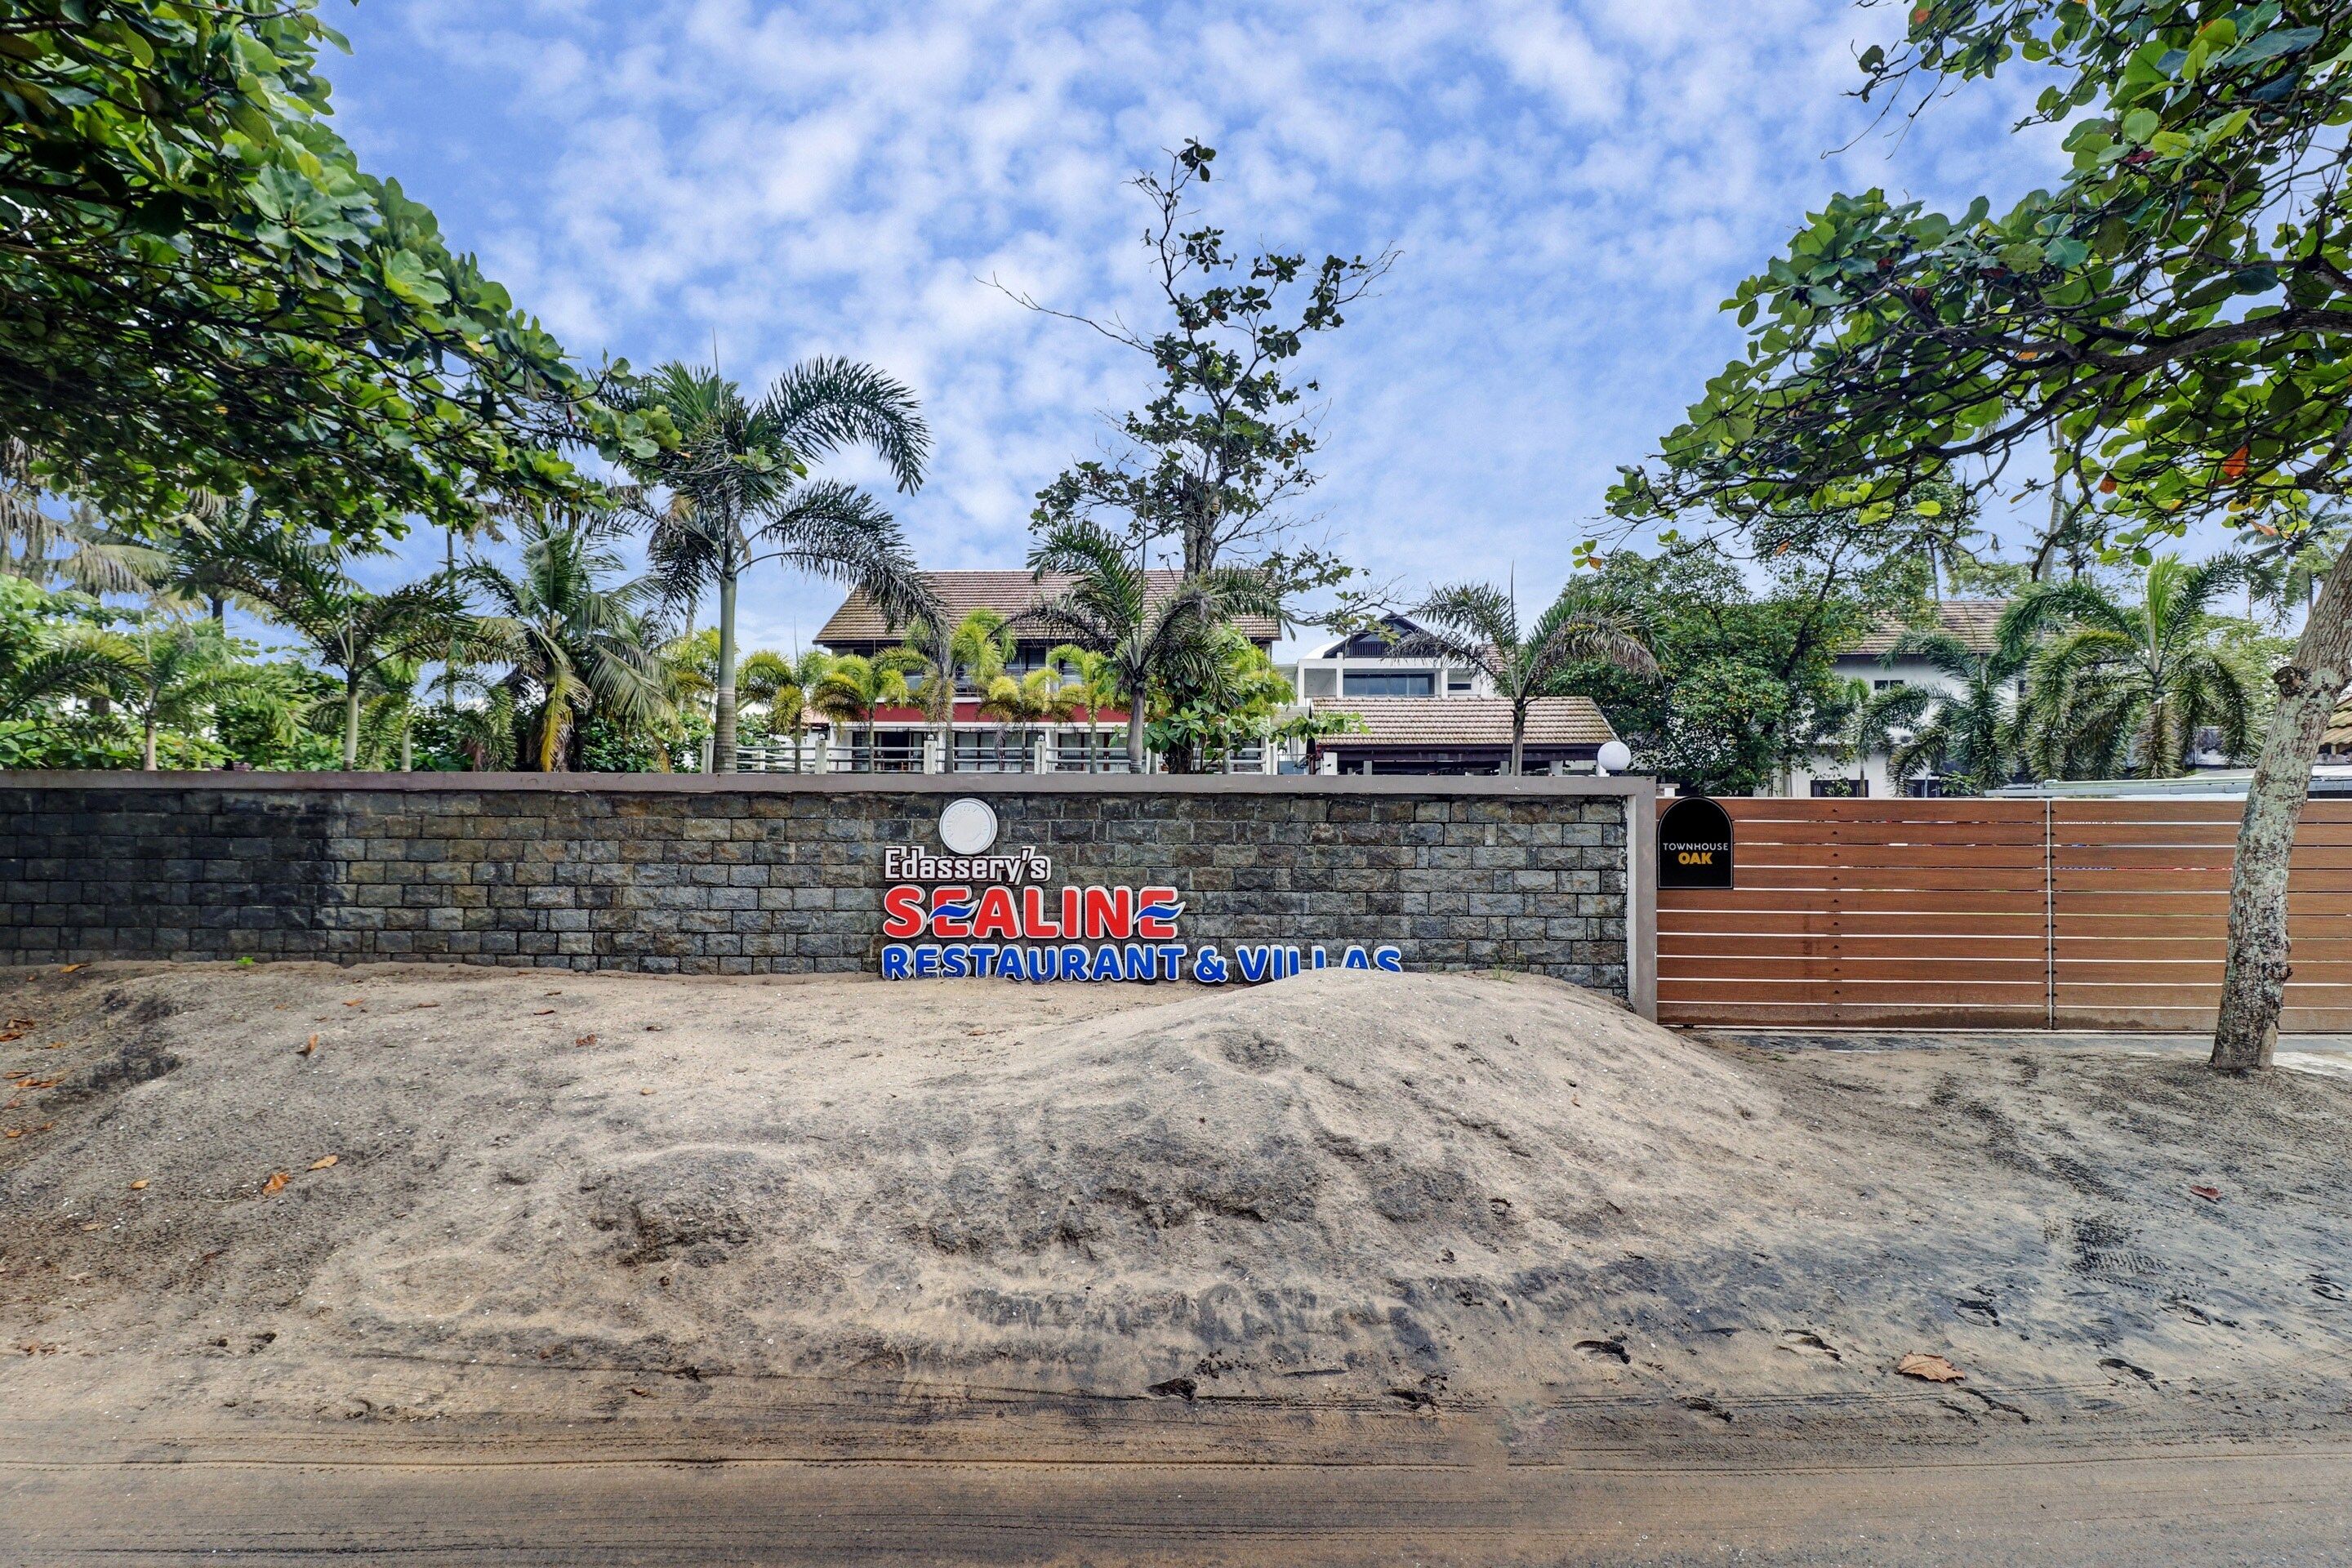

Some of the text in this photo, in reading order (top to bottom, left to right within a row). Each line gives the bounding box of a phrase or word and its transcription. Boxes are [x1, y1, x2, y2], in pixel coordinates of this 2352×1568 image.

[884, 846, 1051, 884] Edassery's
[1663, 843, 1729, 851] TOWNHOUSE
[1678, 853, 1713, 865] OAK
[883, 885, 1186, 939] SEALINE
[881, 944, 1188, 982] RESTAURANT
[1193, 945, 1229, 982] &
